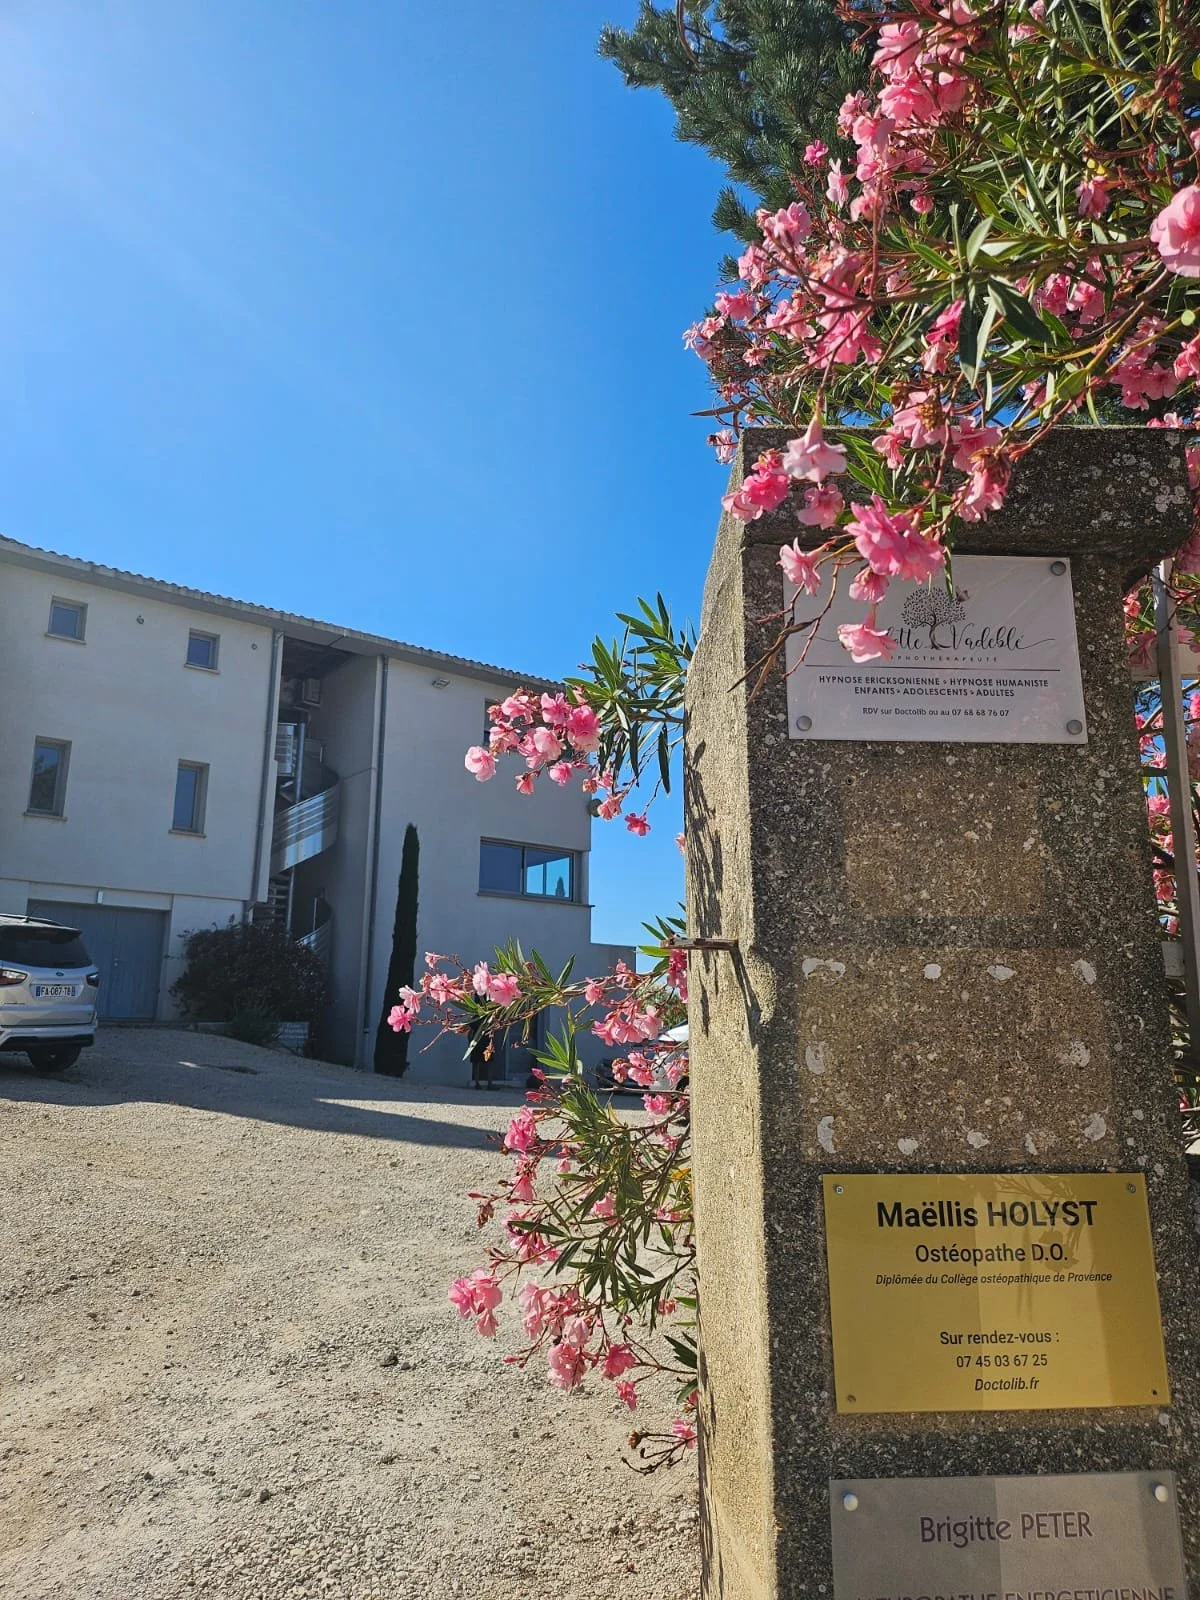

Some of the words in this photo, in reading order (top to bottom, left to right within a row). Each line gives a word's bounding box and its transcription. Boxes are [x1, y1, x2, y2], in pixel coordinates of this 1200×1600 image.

[819, 675, 861, 684] HYPNOSE
[865, 676, 940, 686] ERICKSONIENNE
[950, 678, 993, 686] HYPNOSE
[996, 679, 1049, 687] HUMANISTE
[854, 686, 895, 695] ENFANTS
[903, 687, 968, 696] ADOLESCENTS
[976, 689, 1015, 697] ADULTES
[862, 707, 878, 715] RDV
[894, 707, 927, 716] Doctolib
[951, 708, 962, 716] 07
[999, 709, 1010, 717] 07
[877, 1201, 978, 1228] Maëllis
[986, 1200, 1098, 1227] HOLYST
[915, 1243, 1027, 1267] Ostéopathe
[1031, 1243, 1068, 1262] D.O.
[875, 1273, 923, 1287] Diplômée
[925, 1273, 938, 1284] du
[940, 1273, 978, 1286] Collège
[980, 1272, 1051, 1286] ostéopathique
[1053, 1272, 1065, 1282] de
[1067, 1272, 1112, 1282] Provence
[939, 1331, 963, 1345] Sur
[966, 1330, 1052, 1345] rendez-vous
[955, 1355, 972, 1368] 07
[975, 1355, 991, 1368] 45
[994, 1354, 1010, 1367] 03
[1013, 1354, 1029, 1367] 67
[1032, 1353, 1048, 1367] 25
[974, 1377, 1040, 1392] Doctolib.fr
[920, 1514, 1012, 1549] Brigitte
[1020, 1511, 1093, 1540] PETER
